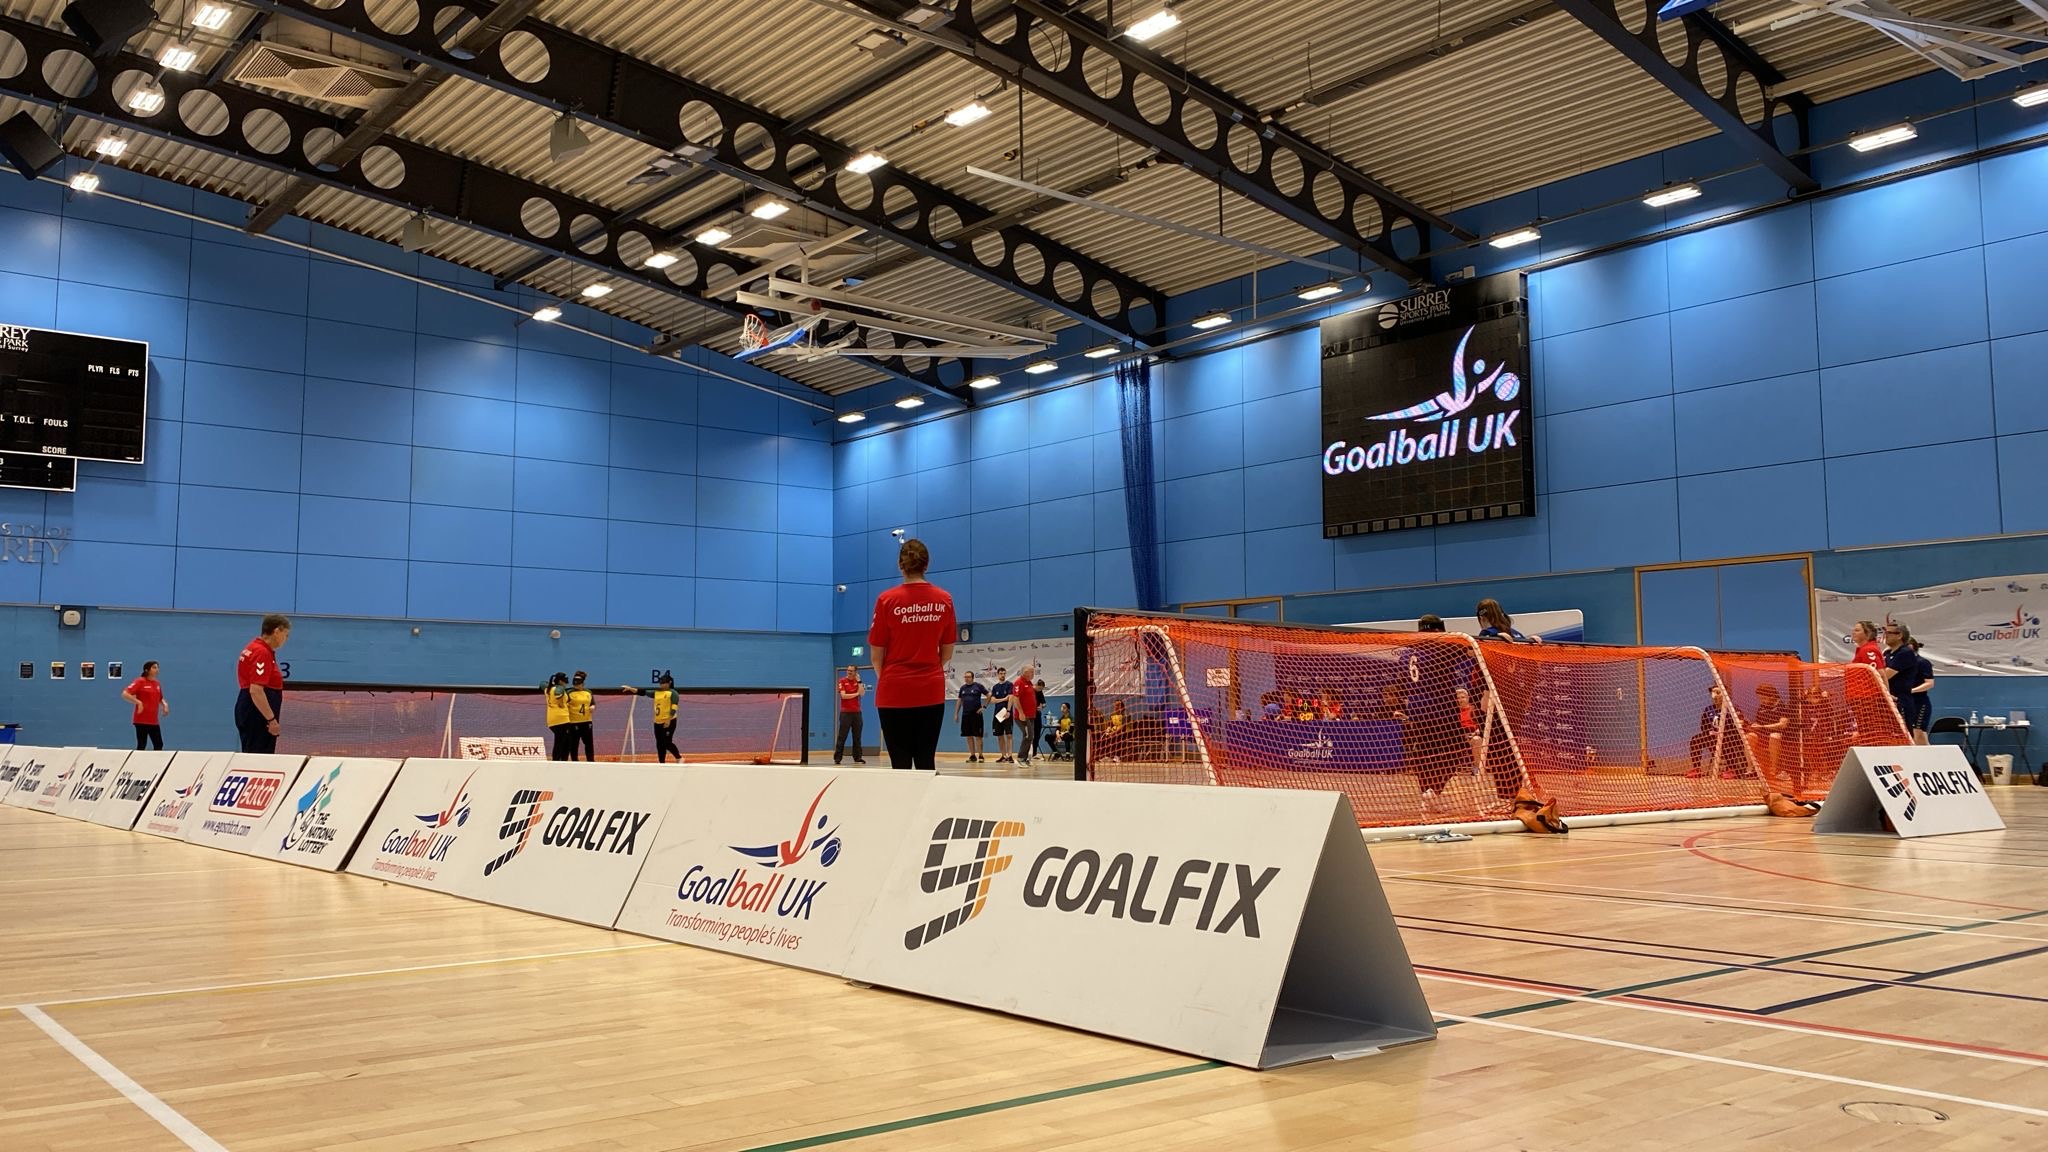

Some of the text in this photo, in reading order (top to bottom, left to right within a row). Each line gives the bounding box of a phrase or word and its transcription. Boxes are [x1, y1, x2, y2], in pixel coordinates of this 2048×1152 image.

[1400, 288, 1451, 313] SURREY
[1400, 302, 1450, 320] SPORTS PARK
[4, 338, 28, 348] PARK
[8, 345, 28, 353] Surrey
[88, 364, 139, 377] PLYR FLS PTS
[43, 418, 69, 427] FOULS
[1323, 409, 1521, 476] Goalball UK
[42, 445, 67, 455] SCORE
[46, 461, 53, 469] 4
[893, 603, 946, 616] Goalball UK
[901, 613, 942, 624] Activator
[1967, 628, 2041, 641] Goalball UK
[579, 703, 586, 716] 4
[494, 745, 540, 756] GOALFIX
[1321, 748, 1334, 759] UK
[1912, 770, 1979, 796] GOALFIX
[315, 812, 331, 825] THE
[306, 825, 338, 841] NATIONAL
[542, 805, 651, 856] GOALFIX
[297, 839, 329, 854] LOTTERY
[381, 828, 458, 862] Goalball UK
[677, 864, 828, 921] Goalball UK
[1022, 845, 1281, 939] GOALFIX
[666, 908, 803, 950] Transforming people's lives
